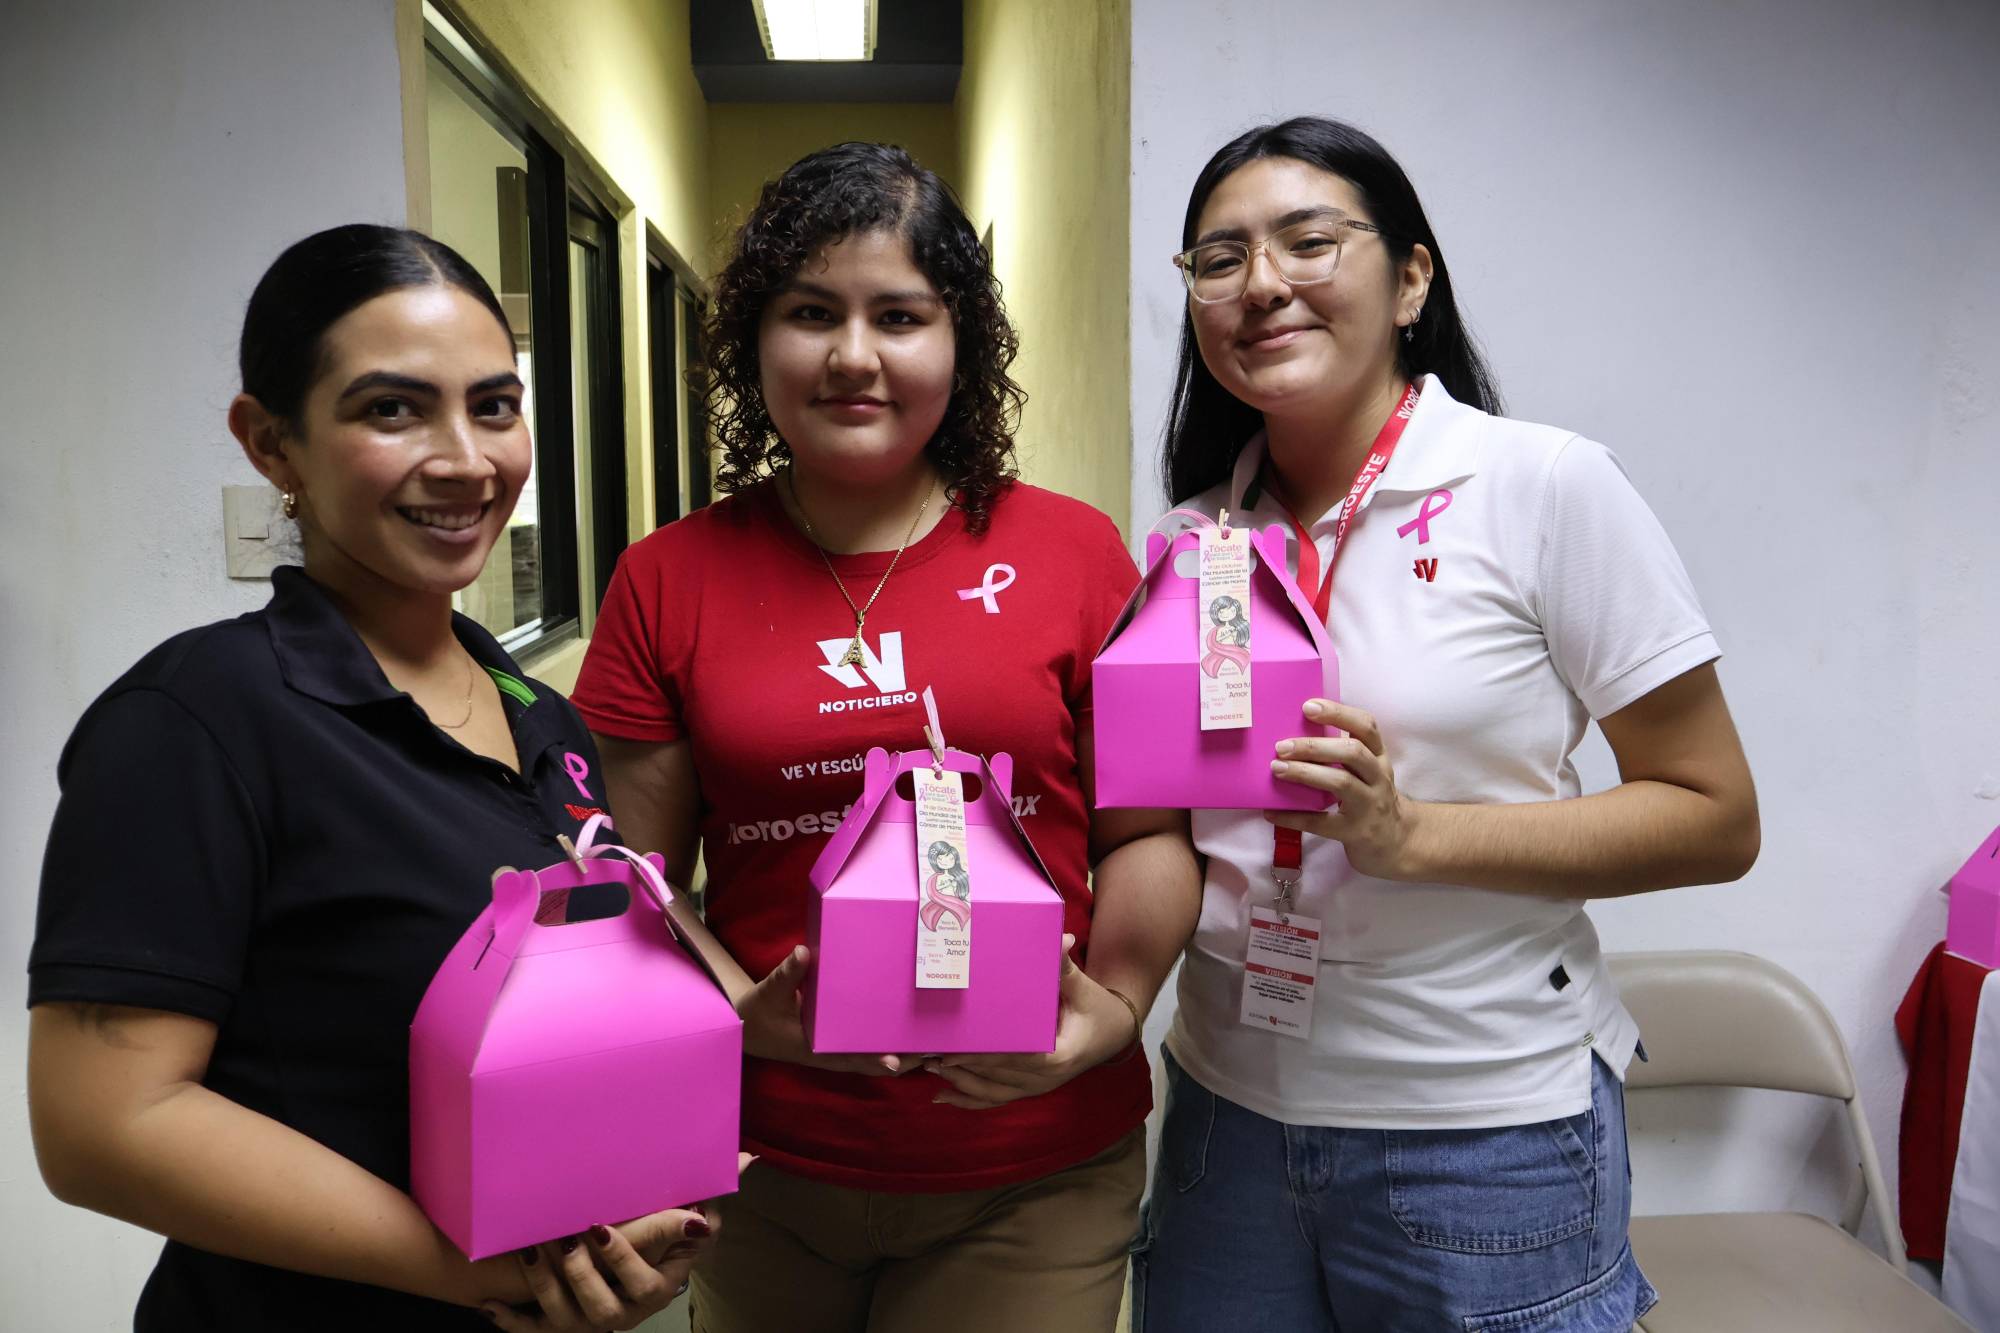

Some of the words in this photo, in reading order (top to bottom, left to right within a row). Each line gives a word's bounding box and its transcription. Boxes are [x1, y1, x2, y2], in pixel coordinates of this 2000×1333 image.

[1226, 682, 1243, 690] Toca
[818, 691, 918, 714] NOTICIERO
[1210, 713, 1245, 721] NOROESTE
[781, 764, 805, 780] VE
[806, 761, 818, 776] Y
[821, 753, 865, 775] ESCÚ
[944, 938, 961, 946] Toca
[962, 938, 969, 946] tu
[947, 948, 966, 956] Amor
[926, 972, 961, 980] NOROESTE
